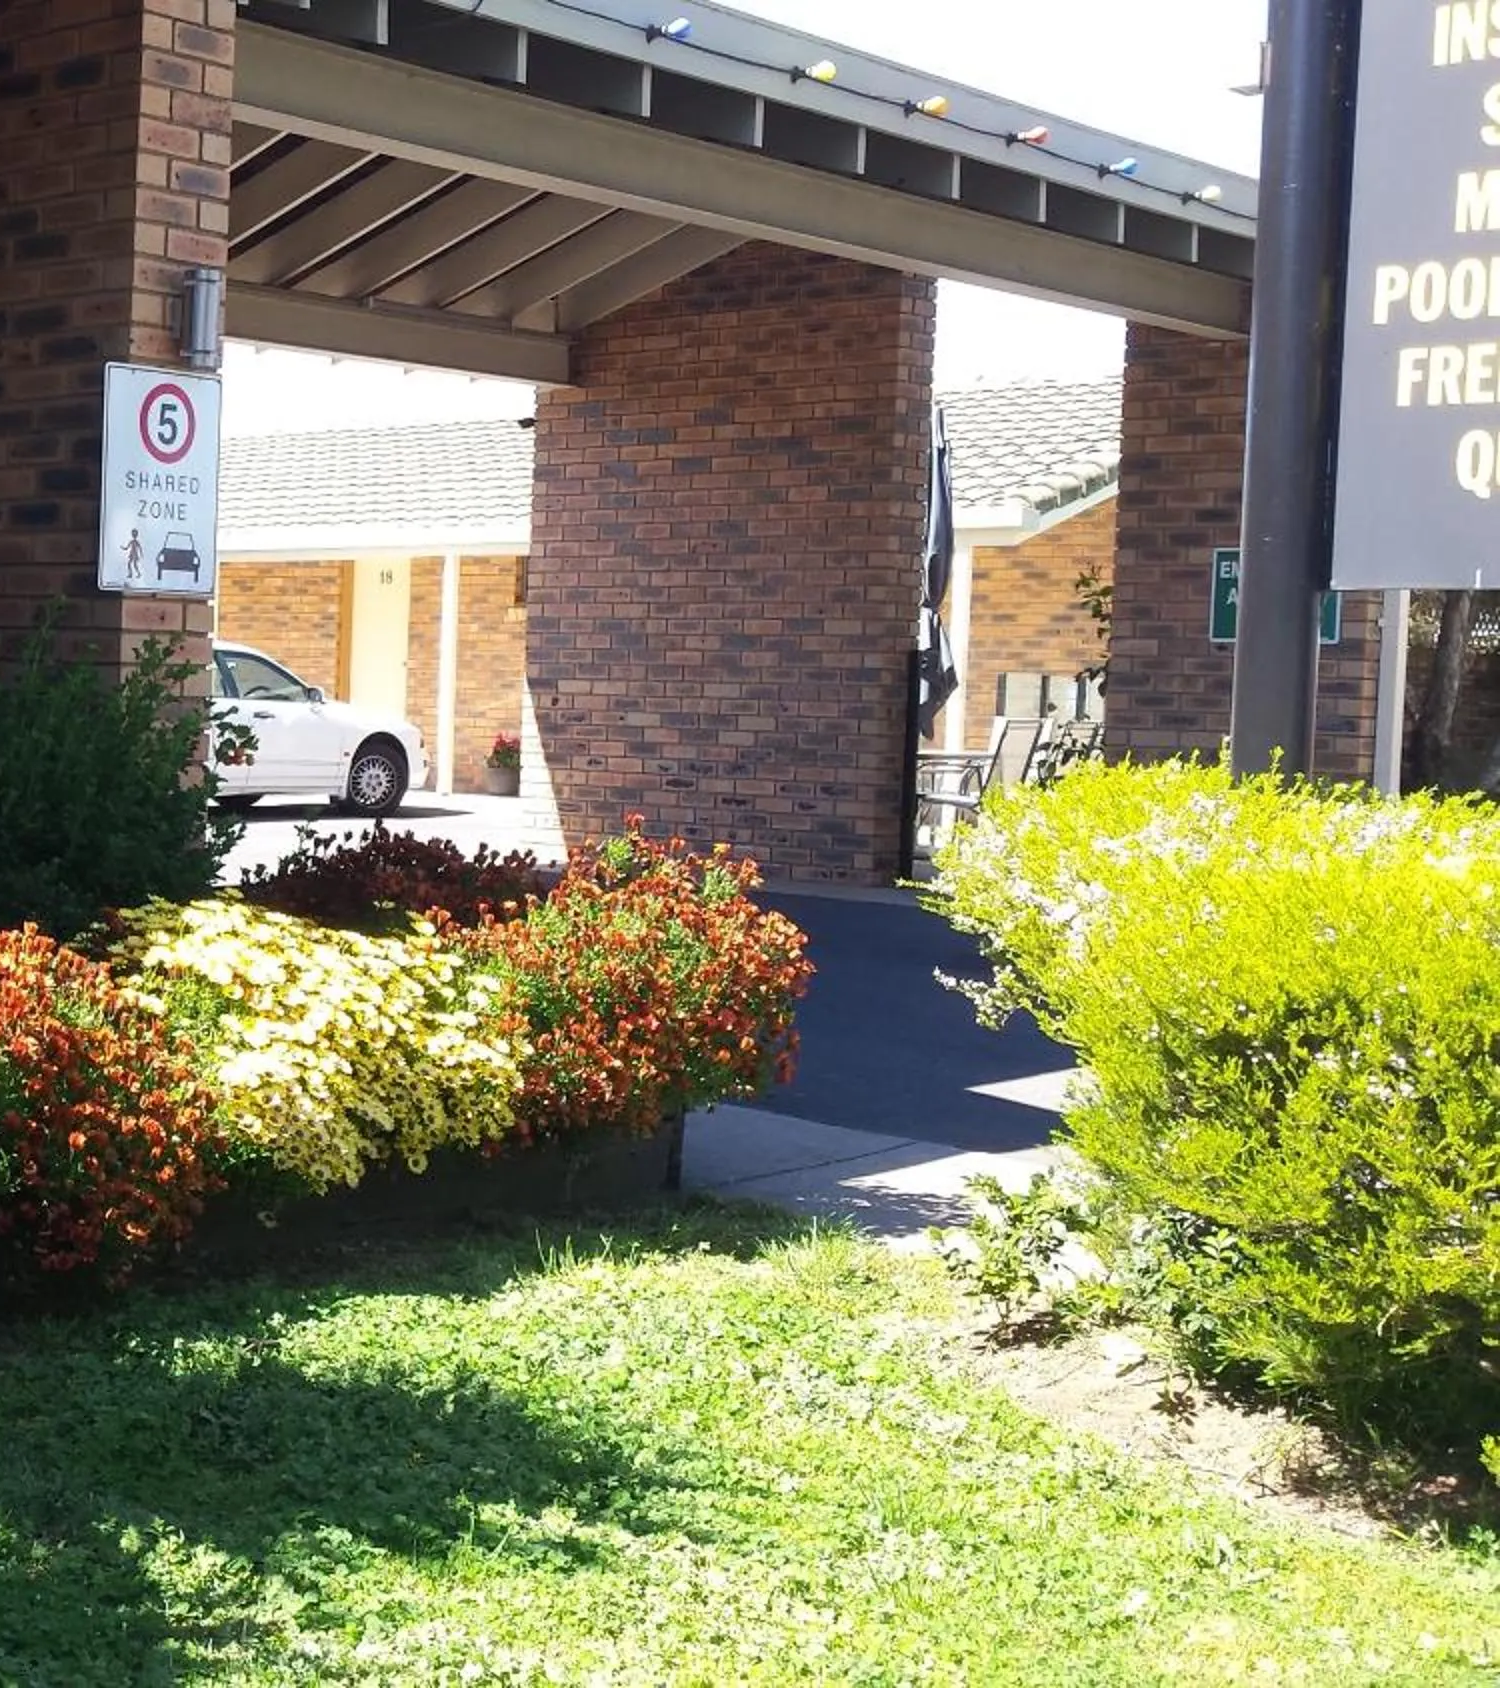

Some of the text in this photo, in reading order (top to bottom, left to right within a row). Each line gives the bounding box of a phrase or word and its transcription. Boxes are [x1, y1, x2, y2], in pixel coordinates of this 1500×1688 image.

[1396, 343, 1500, 407] FRE
[157, 403, 178, 445] 5
[1456, 429, 1500, 499] Q
[125, 470, 200, 495] SHARED
[137, 499, 189, 521] ZONE
[380, 569, 393, 585] 18
